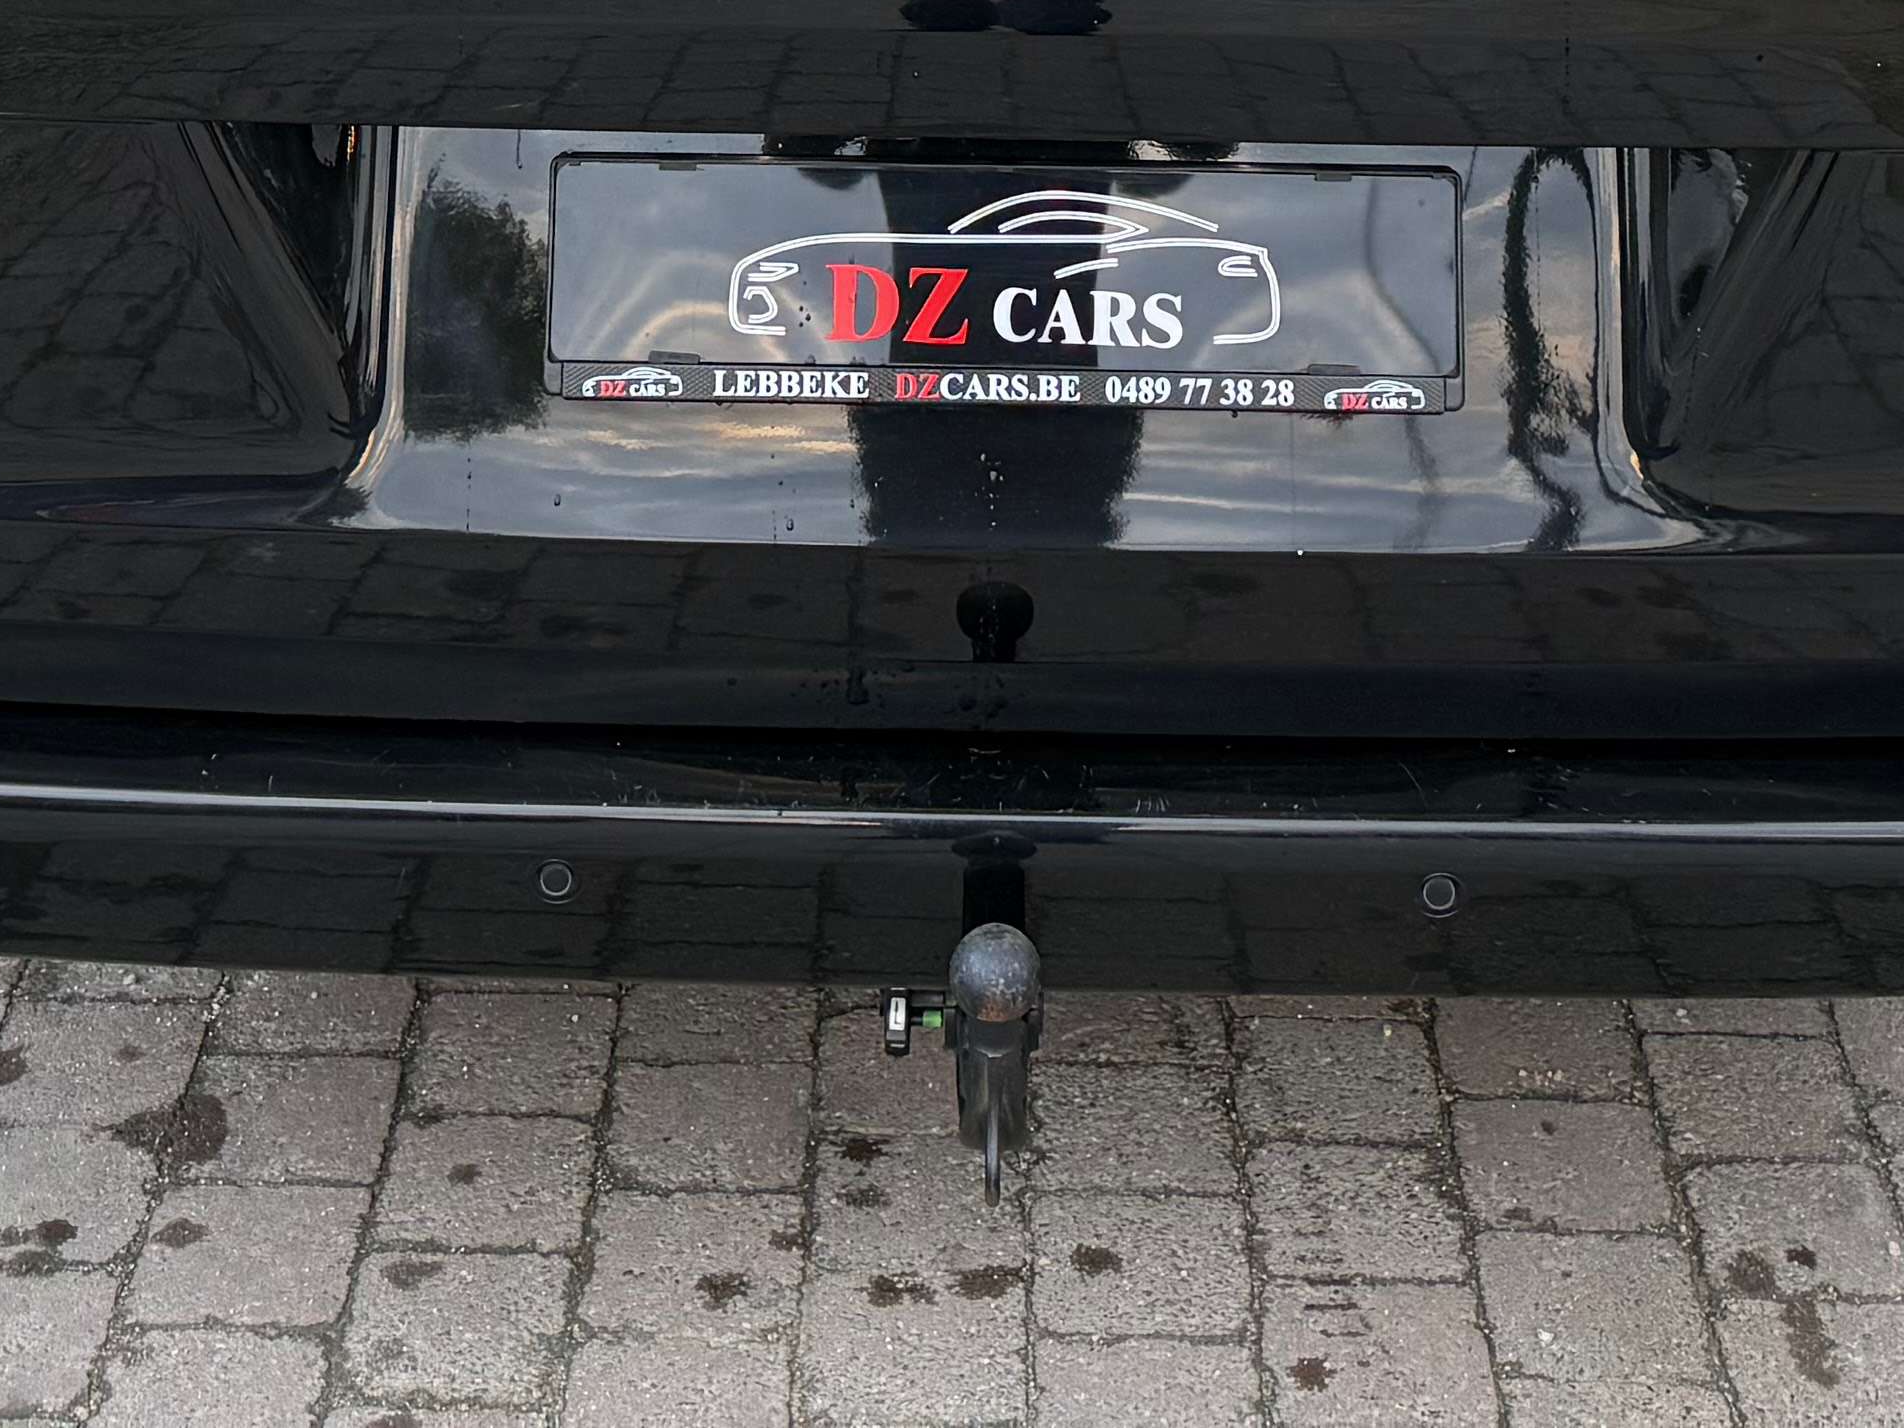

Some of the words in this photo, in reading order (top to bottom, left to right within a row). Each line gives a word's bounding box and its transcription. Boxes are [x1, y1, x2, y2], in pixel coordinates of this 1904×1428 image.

[823, 263, 970, 346] DZ
[992, 286, 1184, 350] CARS
[599, 380, 627, 398] DZ
[629, 381, 666, 398] CARS
[712, 369, 870, 400] LEBBEKE
[894, 372, 1082, 403] DZCARS.BE
[1104, 375, 1173, 404] 0489
[1179, 377, 1213, 406] 77
[1219, 378, 1254, 407] 38
[1260, 379, 1295, 407] 28
[1340, 393, 1370, 410] DZ
[1370, 394, 1409, 409] CARS
